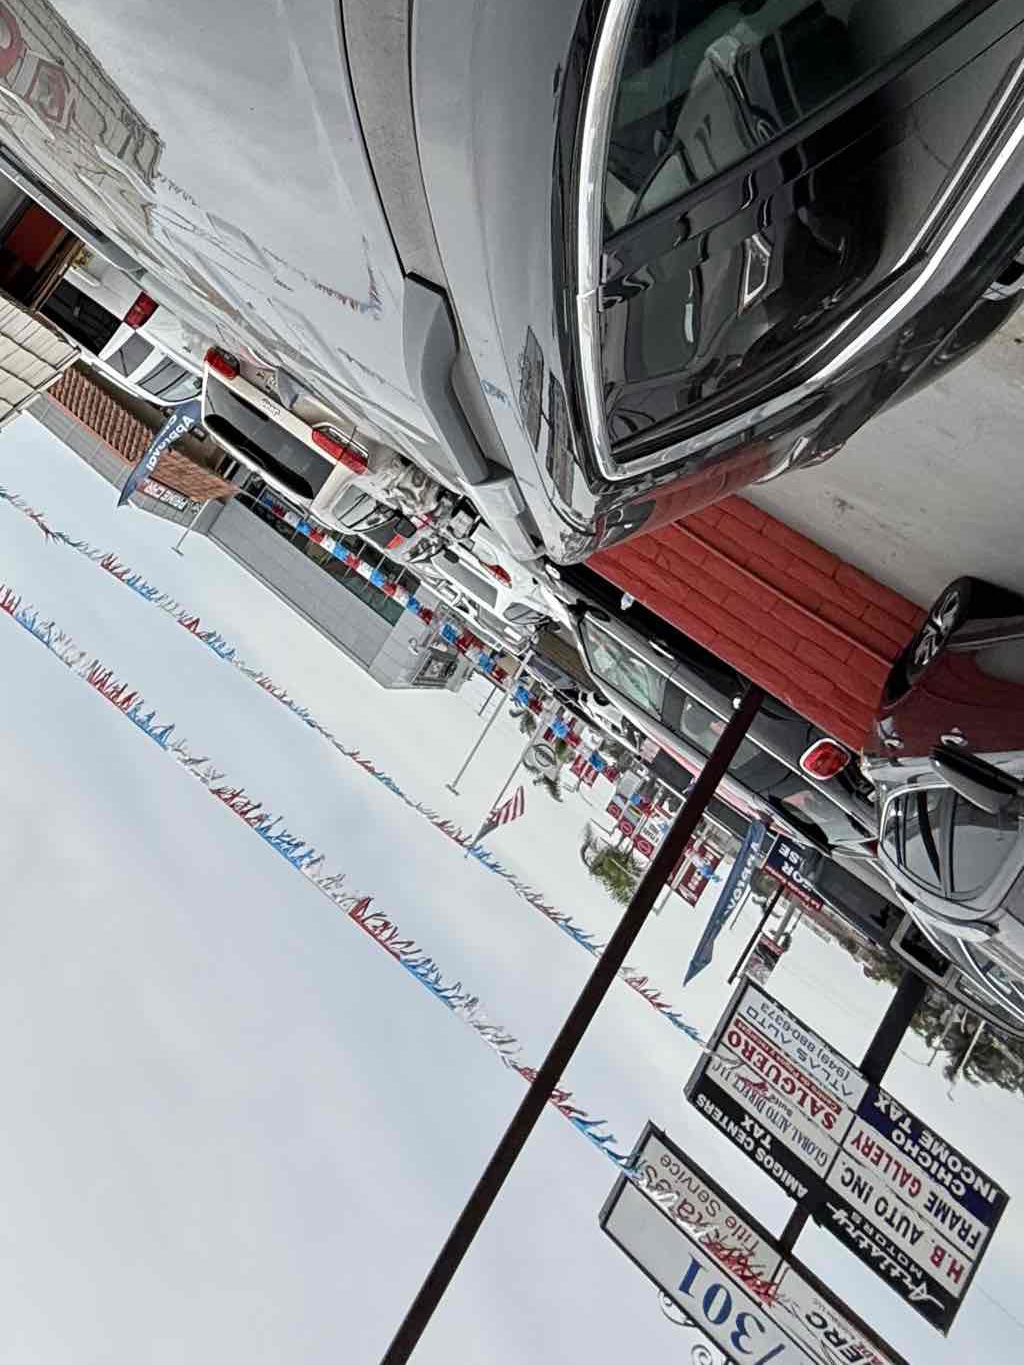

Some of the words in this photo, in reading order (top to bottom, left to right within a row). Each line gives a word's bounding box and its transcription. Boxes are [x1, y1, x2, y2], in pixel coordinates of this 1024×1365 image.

[724, 1028, 838, 1130] SALGUERO
[693, 1092, 755, 1151] CENTERS
[739, 1112, 772, 1149] TAX
[763, 1104, 792, 1132] AUTO
[874, 1093, 912, 1133] TAX
[752, 1146, 808, 1196] AMIGOS
[789, 1125, 828, 1167] GLOBAL
[850, 1129, 924, 1198] GALLERY
[889, 1127, 967, 1197] CHICHO
[917, 1130, 997, 1202] INCOME
[655, 1150, 722, 1218] Service
[837, 1161, 874, 1203] INC.
[722, 1214, 759, 1254] Title
[850, 1211, 923, 1278] MOTORS
[871, 1195, 924, 1246] AUTO
[921, 1190, 983, 1249] FRAME
[805, 1311, 866, 1365] ERC
